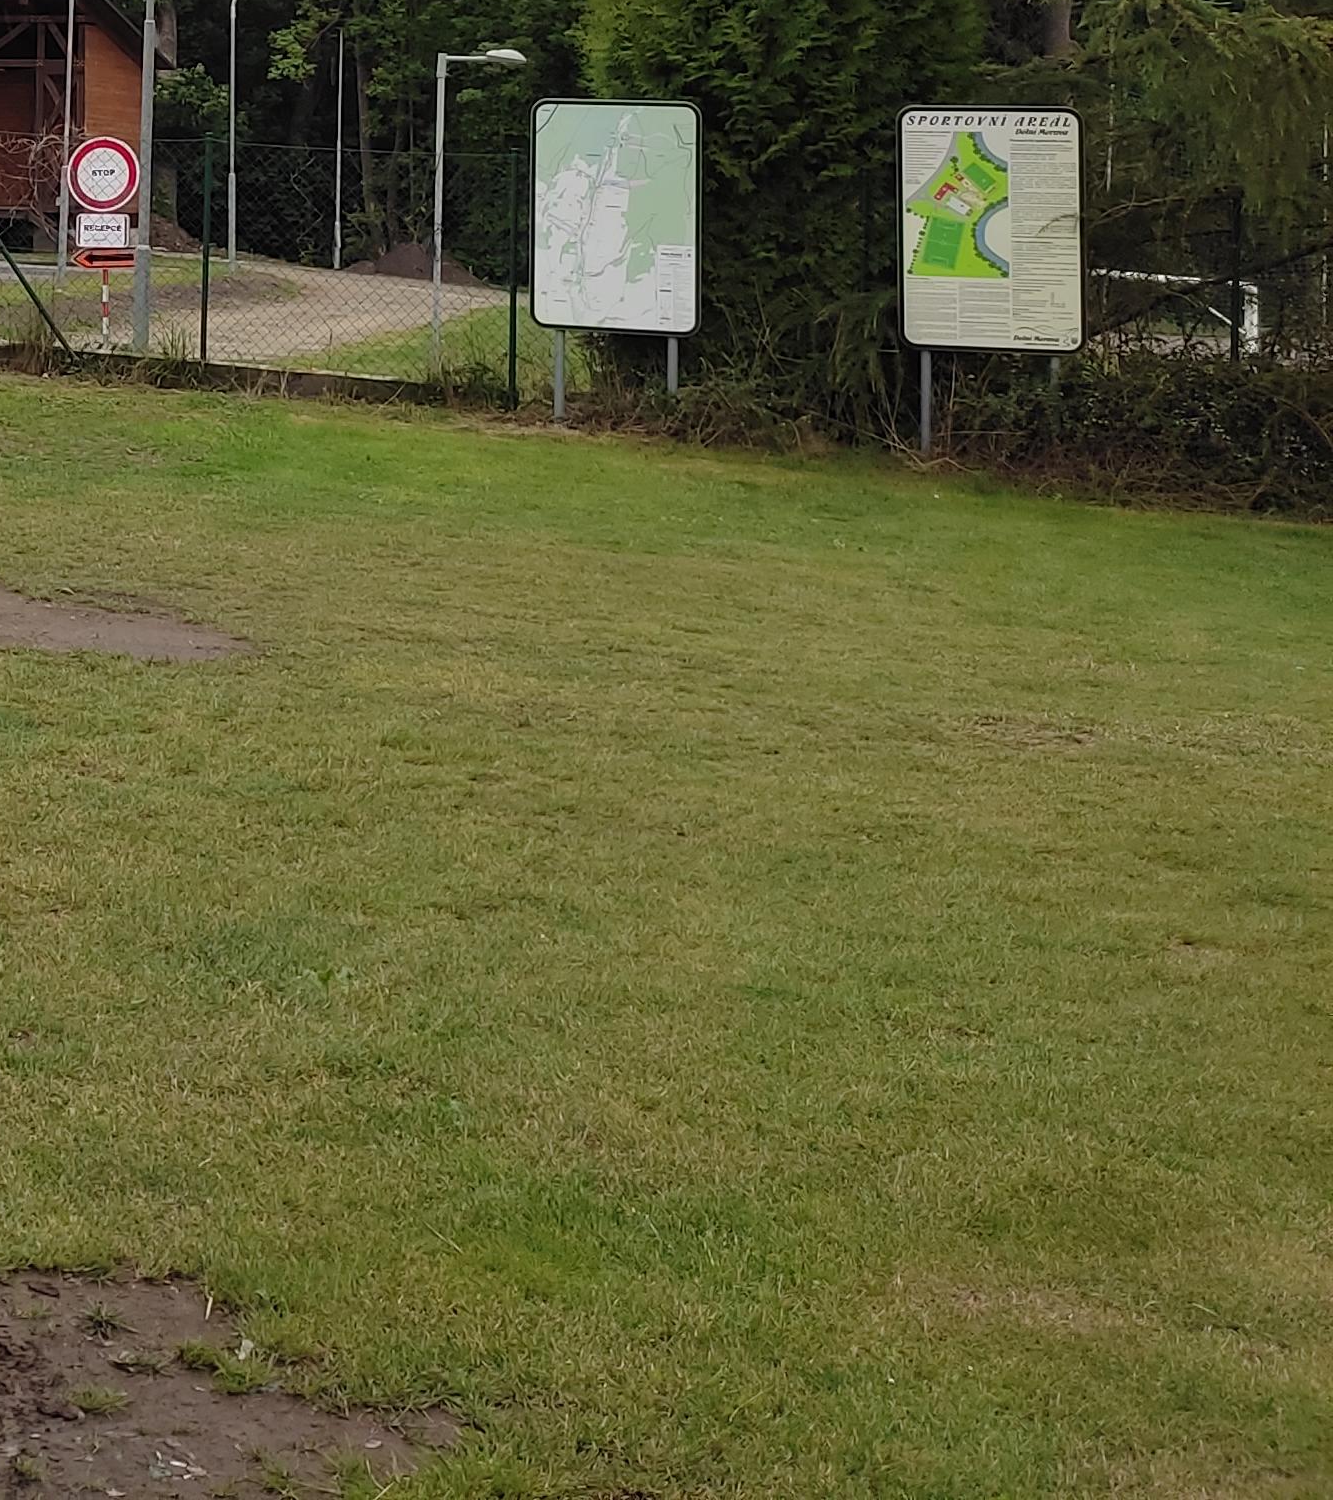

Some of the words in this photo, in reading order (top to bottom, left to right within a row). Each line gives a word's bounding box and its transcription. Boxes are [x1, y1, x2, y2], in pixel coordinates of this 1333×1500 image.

[906, 114, 1008, 127] SPORTOVNÍ
[1014, 114, 1071, 128] AREÁL
[91, 169, 116, 177] STOP
